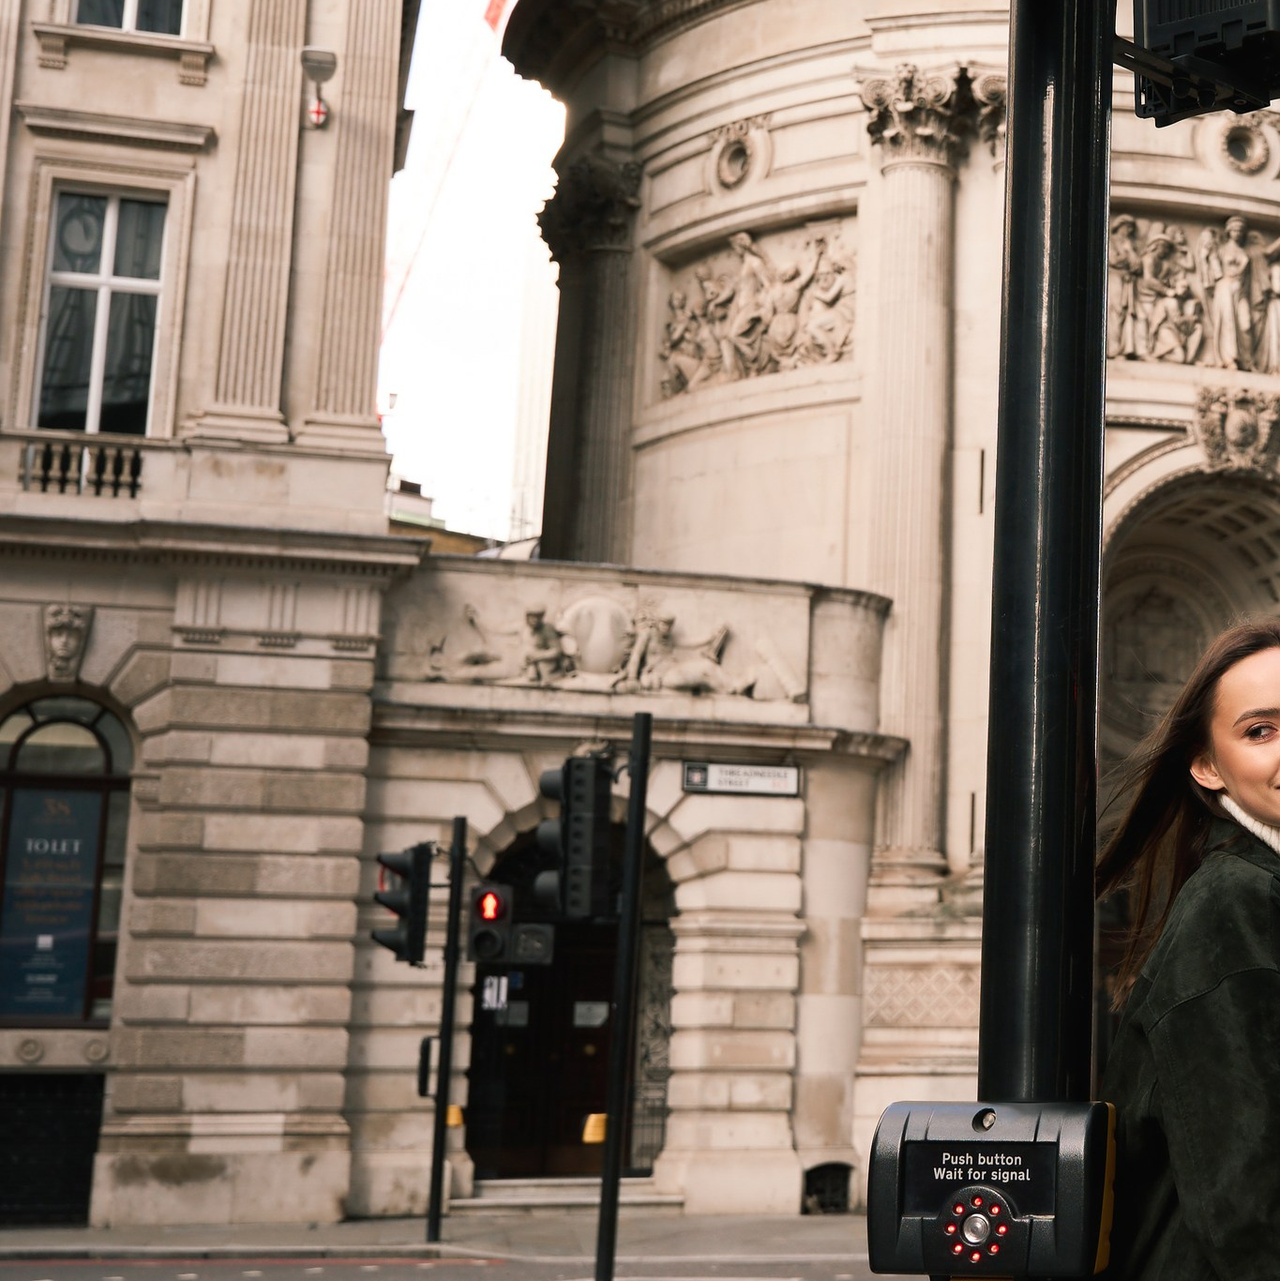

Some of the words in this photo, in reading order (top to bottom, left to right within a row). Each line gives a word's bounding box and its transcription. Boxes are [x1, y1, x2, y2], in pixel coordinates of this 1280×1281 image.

[25, 837, 49, 854] TO
[51, 837, 82, 855] LET
[942, 1152, 973, 1165] Push
[977, 1153, 1022, 1166] button
[933, 1167, 963, 1180] Wait
[967, 1168, 987, 1180] for
[991, 1168, 1031, 1183] signal
